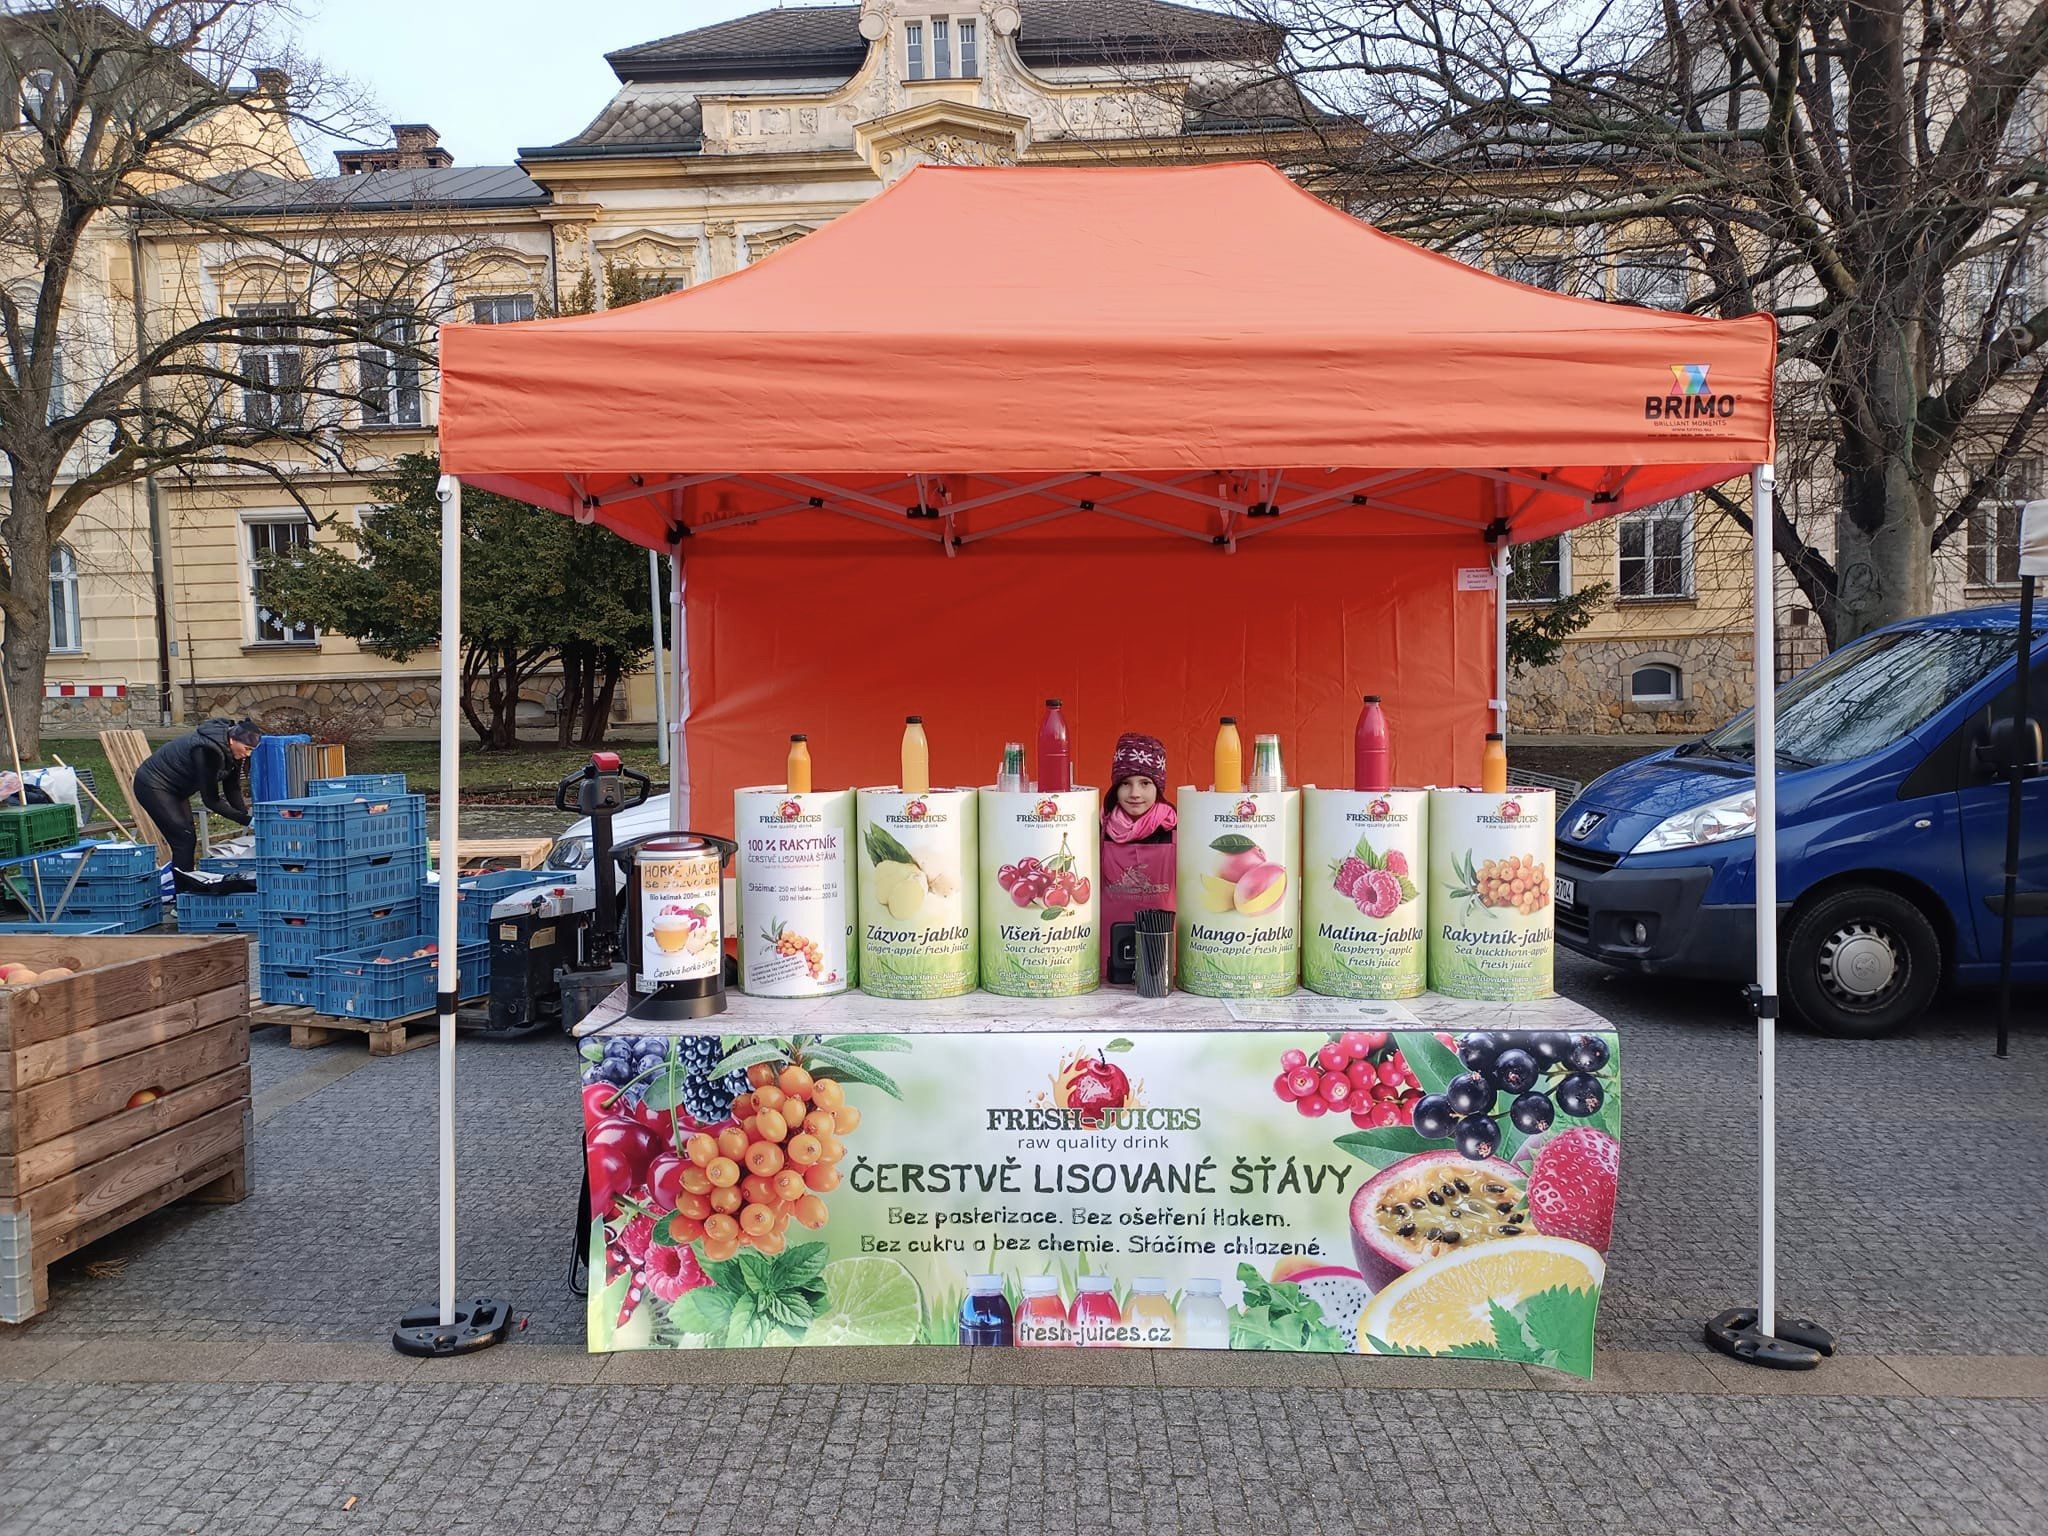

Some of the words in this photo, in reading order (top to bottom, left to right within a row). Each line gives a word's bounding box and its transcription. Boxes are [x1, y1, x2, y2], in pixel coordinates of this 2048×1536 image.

[1645, 395, 1735, 420] BRIMO
[1691, 419, 1727, 427] MOMENTS
[748, 839, 763, 851] 100
[766, 839, 776, 851] %
[780, 834, 837, 851] RAKYTNÍK
[867, 925, 969, 946] Zázvor-jablko
[1000, 925, 1091, 944] Višeň-jablko
[1191, 924, 1293, 945] Mango-jablko
[1319, 923, 1423, 945] Malina-jablko
[867, 942, 922, 956] Ginger-apple
[925, 945, 950, 954] fresh
[1004, 943, 1026, 953] Sour
[1029, 942, 1087, 955] cherry-apple
[1190, 942, 1252, 956] Mango-apple
[1254, 945, 1277, 954] fresh
[1334, 942, 1412, 956] Raspberry-apple
[1455, 945, 1472, 955] Sea
[1022, 956, 1048, 966] fresh
[1050, 956, 1072, 966] juice
[1348, 957, 1376, 966] fresh
[1376, 958, 1400, 968] juice
[1481, 960, 1508, 968] fresh
[1510, 960, 1532, 970] juice
[986, 1108, 1201, 1131] FRESH-JUICES
[1018, 1138, 1050, 1149] raw
[1056, 1135, 1117, 1152] quality
[1123, 1135, 1169, 1149] drink
[850, 1156, 1022, 1193] ČERSTVĚ
[1034, 1156, 1217, 1194] LISOVANÉ
[1230, 1156, 1352, 1194] ŠŤÁVY
[888, 1207, 928, 1225] Bez
[935, 1206, 1063, 1228] pasterizace.
[1072, 1208, 1113, 1225] Bez
[1119, 1207, 1206, 1226] ošetření
[1213, 1208, 1291, 1227] tlakem.
[861, 1235, 901, 1252] Bez
[908, 1234, 965, 1252] cukru
[973, 1237, 986, 1251] a
[993, 1233, 1031, 1251] bez
[1038, 1233, 1120, 1253] chemie.
[1128, 1235, 1216, 1254] Stáčíme
[1224, 1236, 1327, 1256] chlazené.
[1020, 1320, 1172, 1345] fresh-juices.cz
